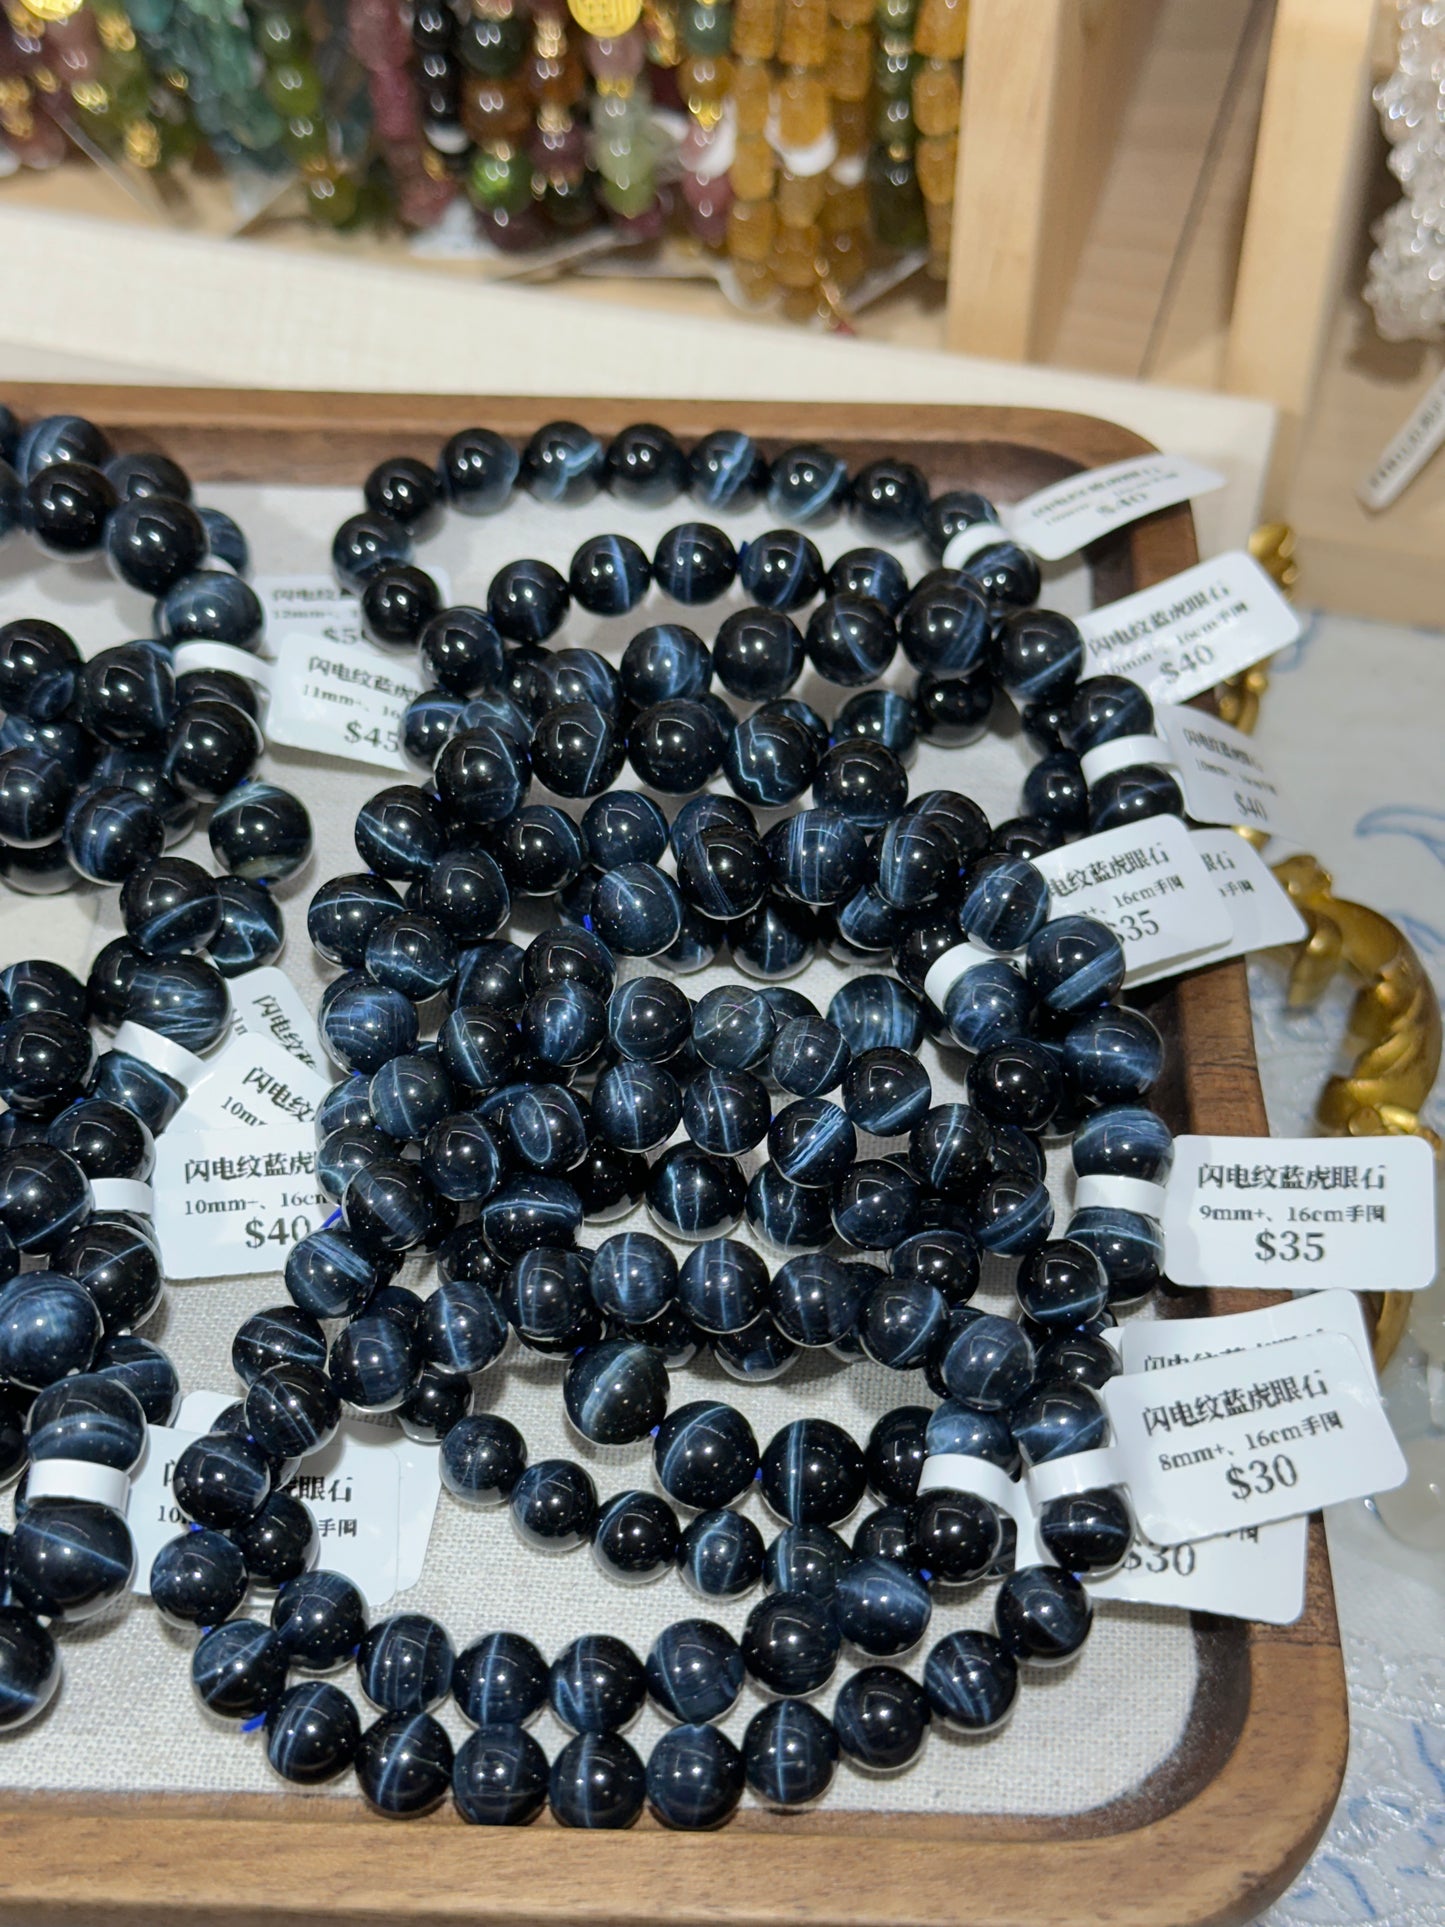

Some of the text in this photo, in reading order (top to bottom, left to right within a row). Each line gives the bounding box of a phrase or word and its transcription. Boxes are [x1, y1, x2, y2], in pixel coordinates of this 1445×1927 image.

[1159, 645, 1215, 684] $40
[343, 719, 399, 753] $45
[220, 1095, 268, 1127] 10m
[1197, 1164, 1387, 1190] 闪电纹蓝虎眼石
[244, 1215, 312, 1250] $40
[1254, 1228, 1326, 1263] $35
[1141, 1369, 1330, 1436] 闪电纹蓝虎眼石
[1224, 1452, 1299, 1503] $30
